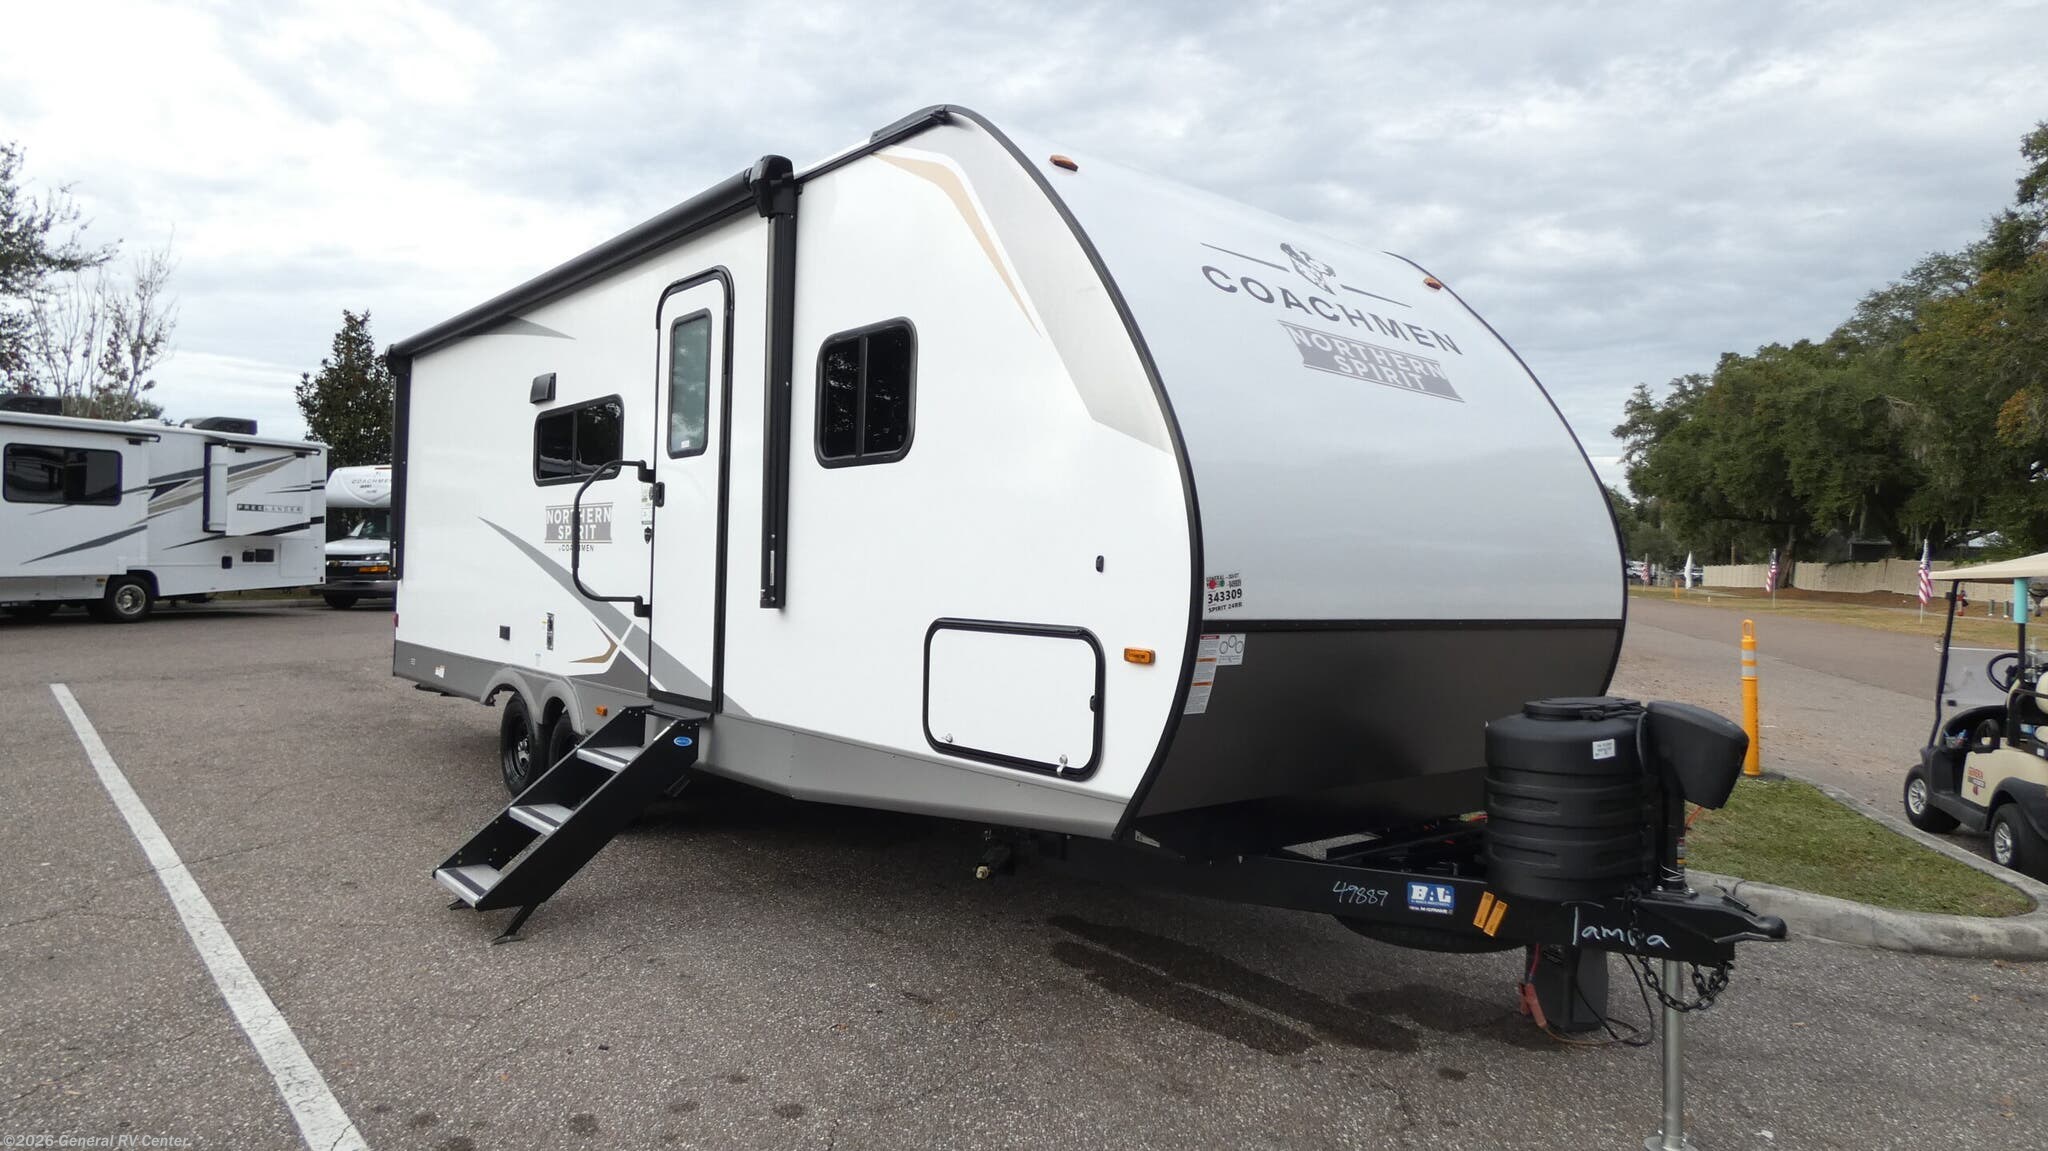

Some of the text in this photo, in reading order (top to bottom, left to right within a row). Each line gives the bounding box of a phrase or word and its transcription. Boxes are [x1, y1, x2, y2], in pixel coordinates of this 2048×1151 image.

[1201, 265, 1464, 355] COACHMEN
[1285, 324, 1449, 380] NORTHERN
[1333, 354, 1426, 391] SPIRIT
[558, 524, 597, 540] SPRIT
[1207, 588, 1243, 605] 343309
[1208, 604, 1227, 613] SPIRIT
[1332, 880, 1389, 907] 49889
